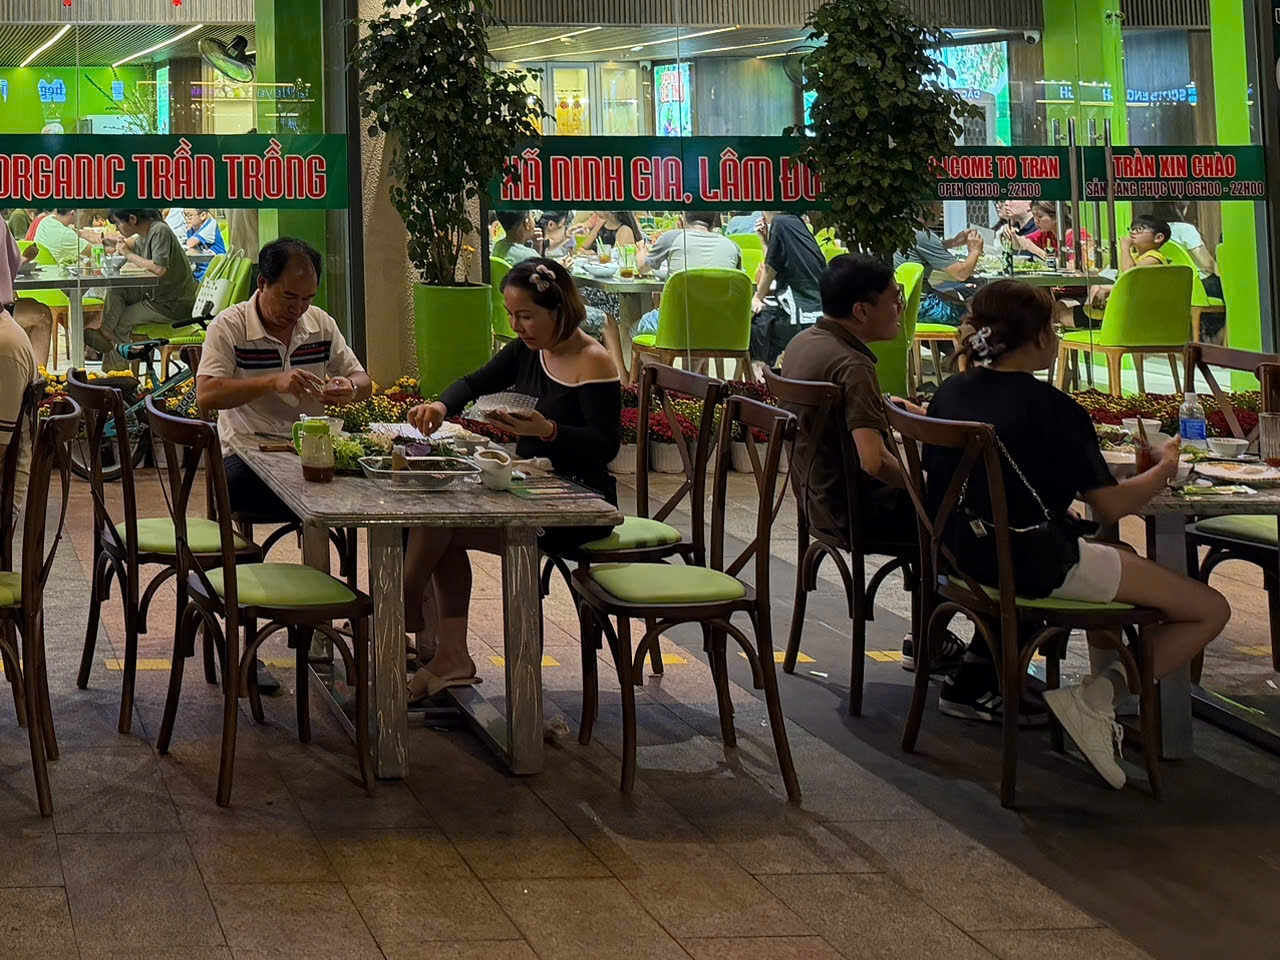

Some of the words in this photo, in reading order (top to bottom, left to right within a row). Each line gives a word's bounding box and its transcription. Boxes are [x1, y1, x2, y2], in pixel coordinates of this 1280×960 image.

[131, 138, 216, 202] TRẦN
[221, 138, 328, 202] TRỒNG
[551, 155, 624, 202] NINH
[630, 155, 694, 205] GIA,
[698, 147, 773, 203] LÂM
[996, 155, 1017, 180] TO
[1020, 155, 1060, 180] TRAN
[1111, 148, 1156, 178] TRẦN
[1159, 154, 1188, 178] XIN
[1192, 151, 1236, 178] CHÀO
[938, 182, 964, 197] OPEN
[965, 182, 999, 197] 06H00
[1008, 182, 1042, 197] 22H00
[1139, 180, 1168, 199] PHỤC
[1169, 180, 1186, 199] VỤ
[1186, 180, 1222, 196] 06H00
[1230, 180, 1265, 196] 22H00
